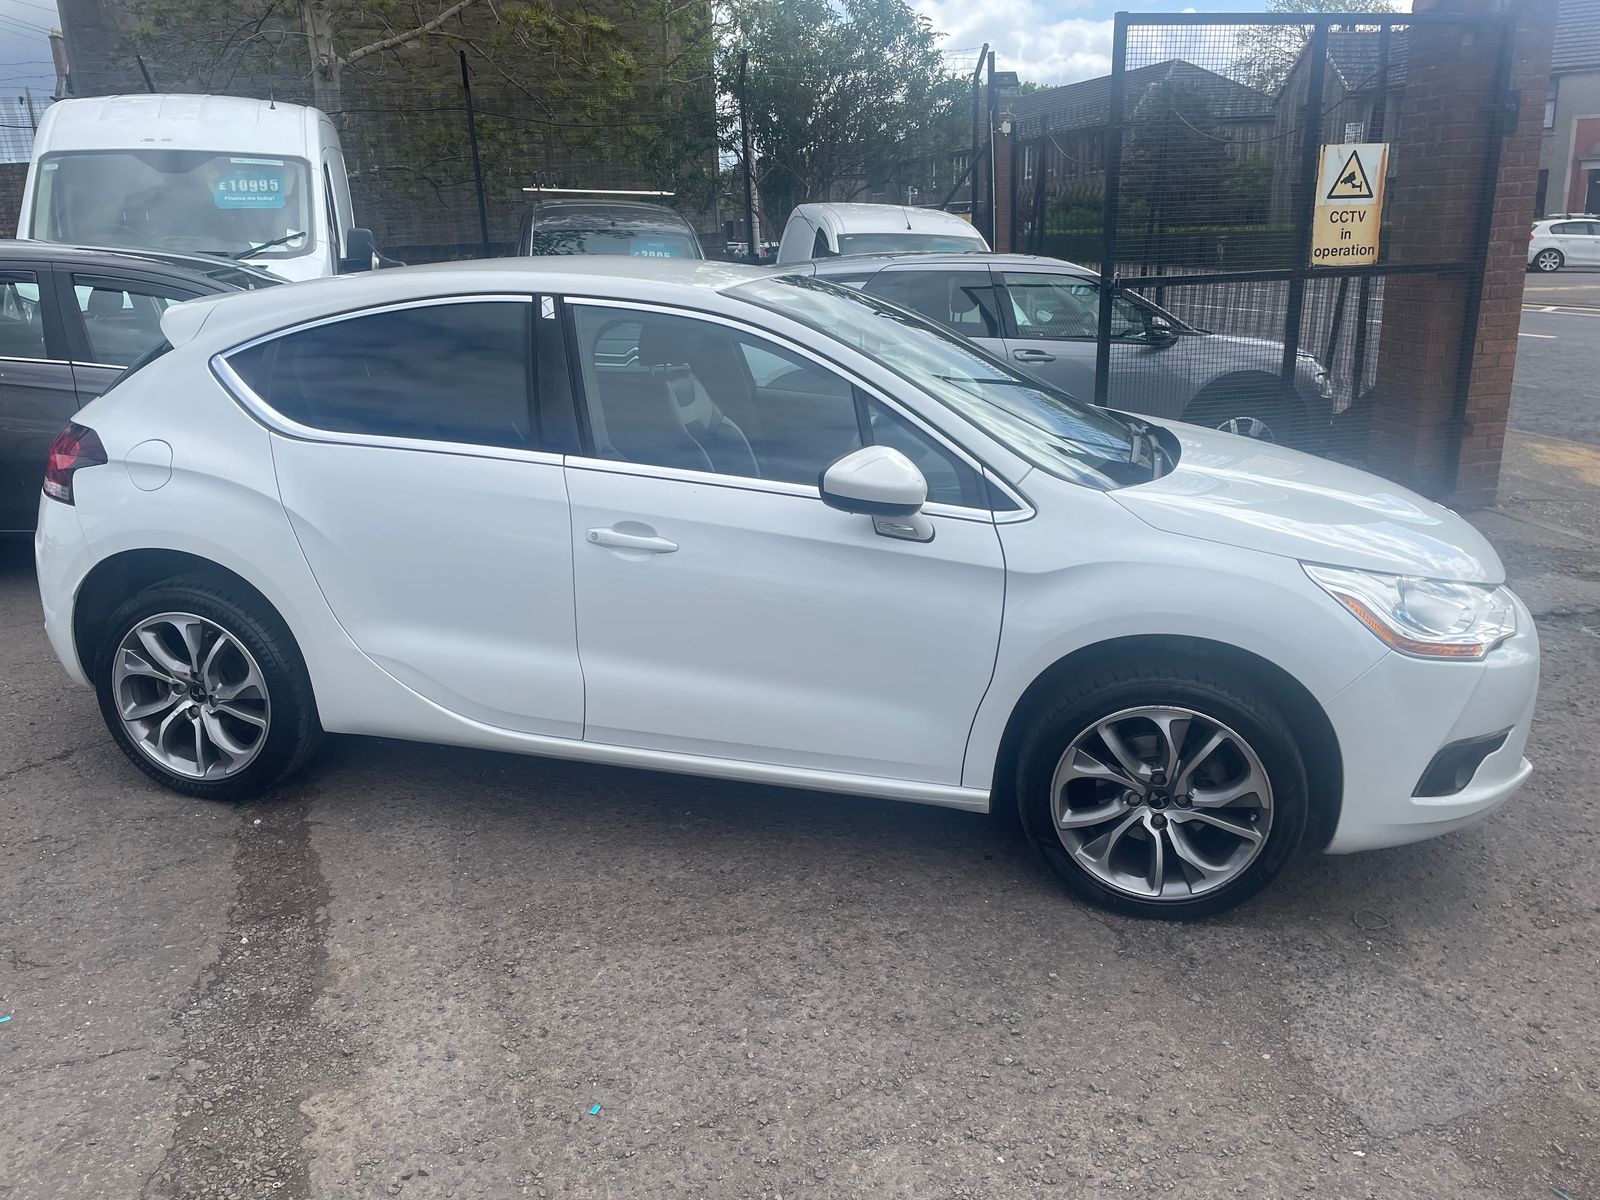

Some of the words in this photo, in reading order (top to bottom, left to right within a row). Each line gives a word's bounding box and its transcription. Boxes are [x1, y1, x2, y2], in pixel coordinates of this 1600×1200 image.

[1330, 210, 1366, 223] CCTV
[1340, 228, 1351, 240] in
[1314, 244, 1375, 259] operation
